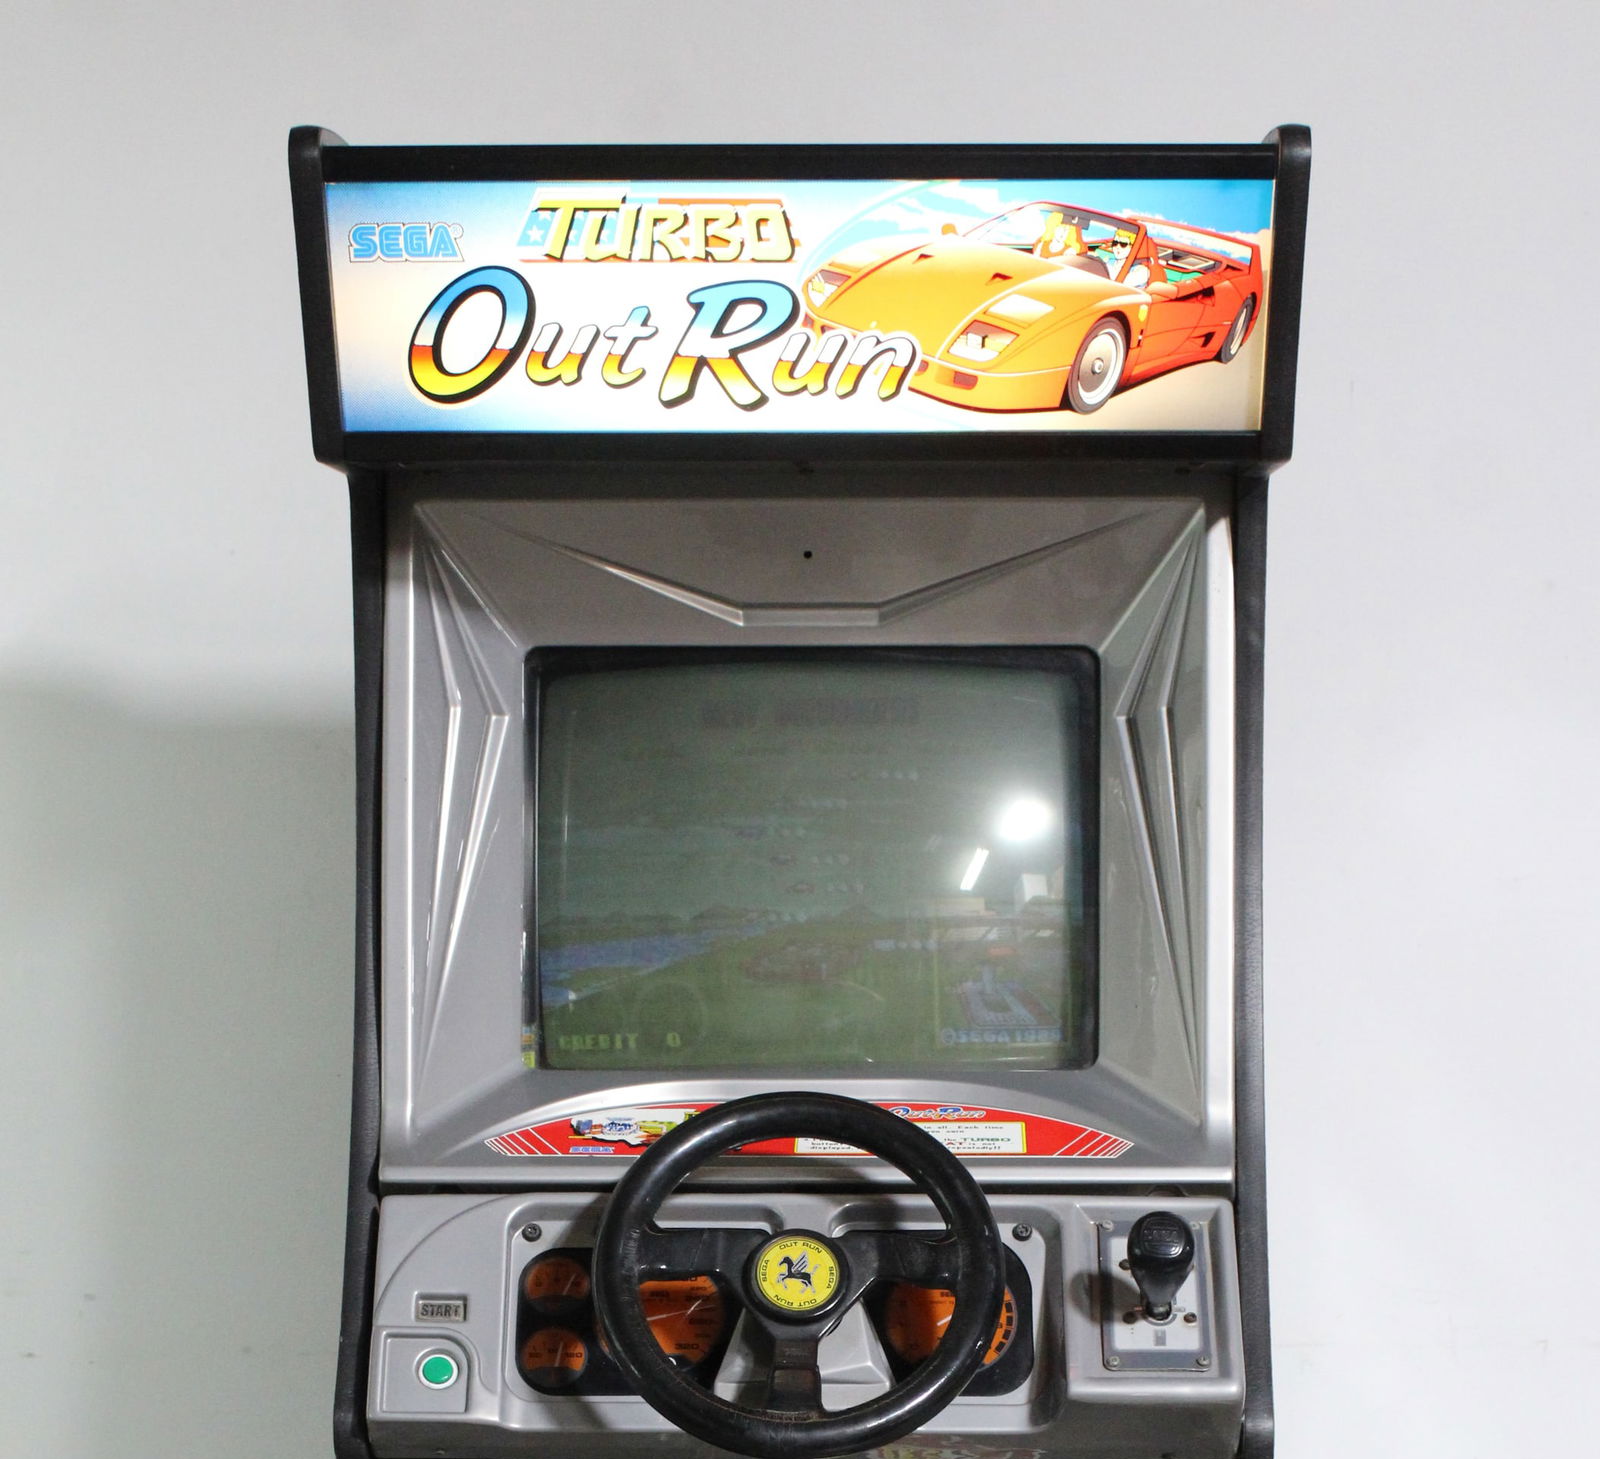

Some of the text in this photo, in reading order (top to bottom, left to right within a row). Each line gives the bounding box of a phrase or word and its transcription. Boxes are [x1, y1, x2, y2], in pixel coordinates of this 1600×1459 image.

[535, 195, 797, 262] TURBO
[408, 265, 917, 411] Out Run
[779, 1241, 822, 1254] OUT RUN
[761, 1259, 770, 1282] SEGA
[826, 1266, 835, 1289] SEGA
[420, 1303, 461, 1317] START
[773, 1294, 817, 1307] OUT RUN
